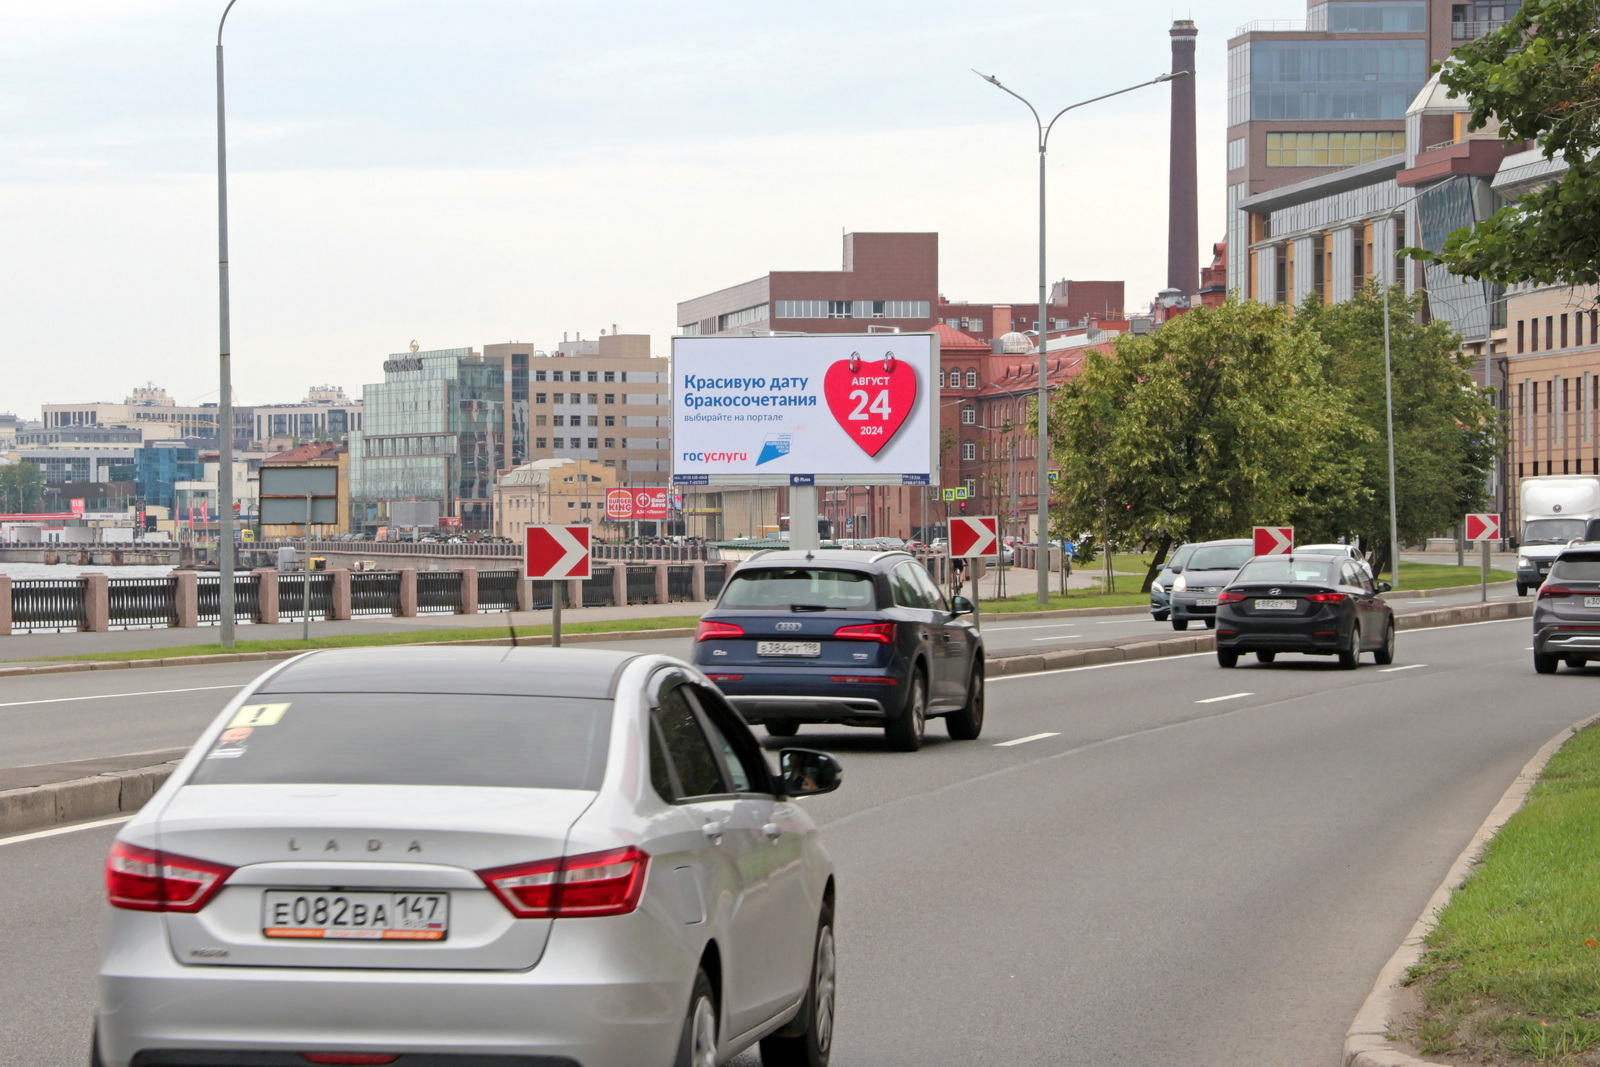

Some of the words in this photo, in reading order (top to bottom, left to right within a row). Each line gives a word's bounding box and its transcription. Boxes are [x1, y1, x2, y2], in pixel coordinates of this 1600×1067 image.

[684, 375, 766, 391] Красивую
[769, 377, 809, 391] дату
[851, 376, 890, 386] АВГУСТ
[684, 393, 817, 409] бракосочетания
[848, 389, 892, 421] 24
[684, 413, 732, 422] выбирайте
[746, 414, 783, 422] портале
[860, 426, 883, 435] 2024
[683, 452, 747, 464] госуслуги
[608, 503, 632, 511] KING
[288, 838, 423, 853] LADA
[273, 896, 388, 927] Е082ВА
[394, 897, 440, 919] 147
